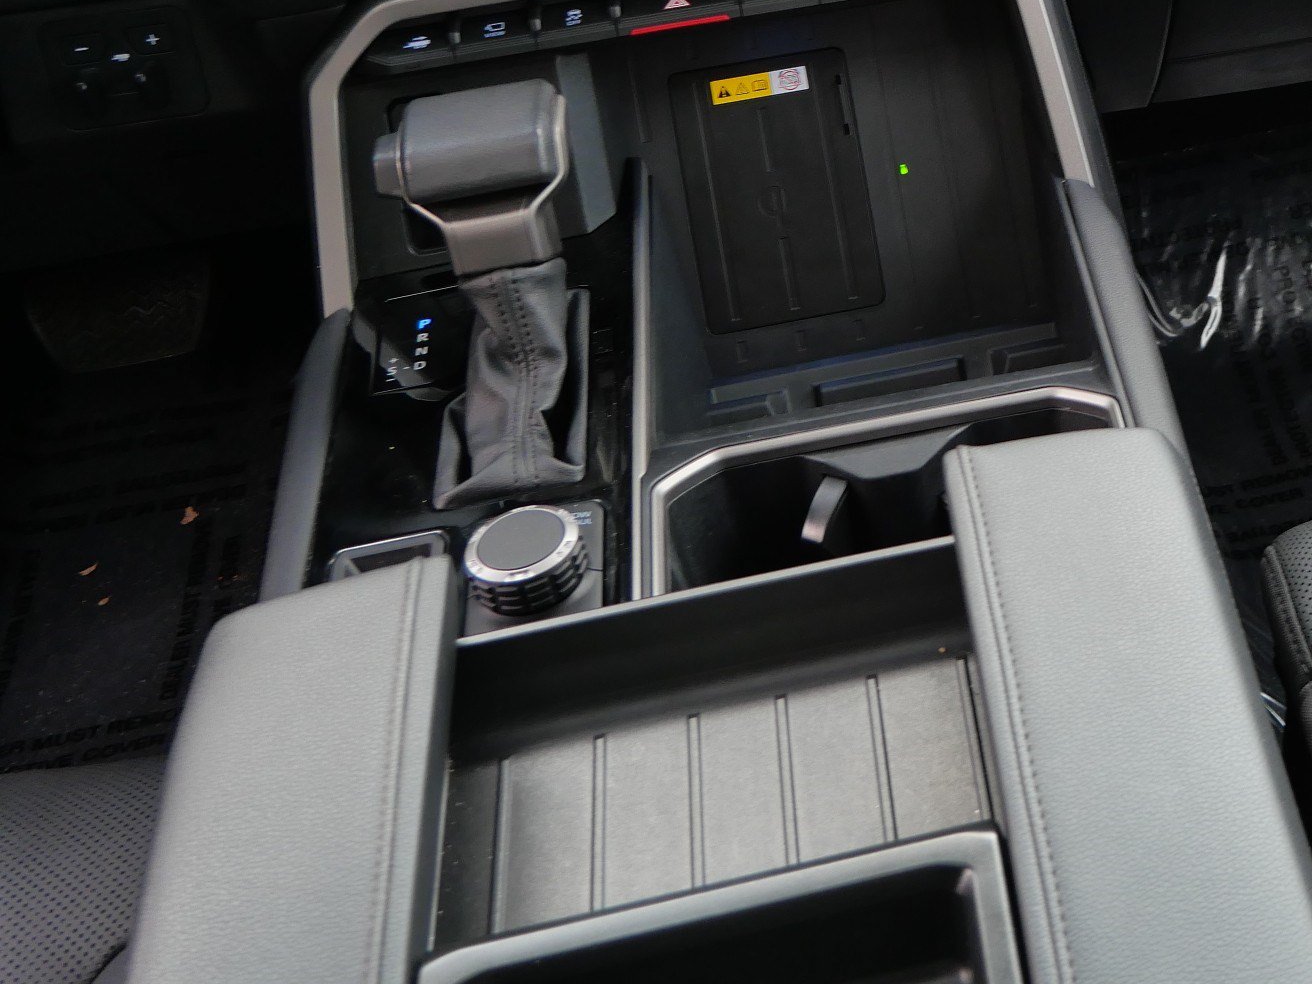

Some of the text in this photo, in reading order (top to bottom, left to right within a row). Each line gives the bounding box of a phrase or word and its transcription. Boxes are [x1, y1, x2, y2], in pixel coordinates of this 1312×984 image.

[413, 318, 432, 371] P R N D
[386, 366, 399, 376] S
